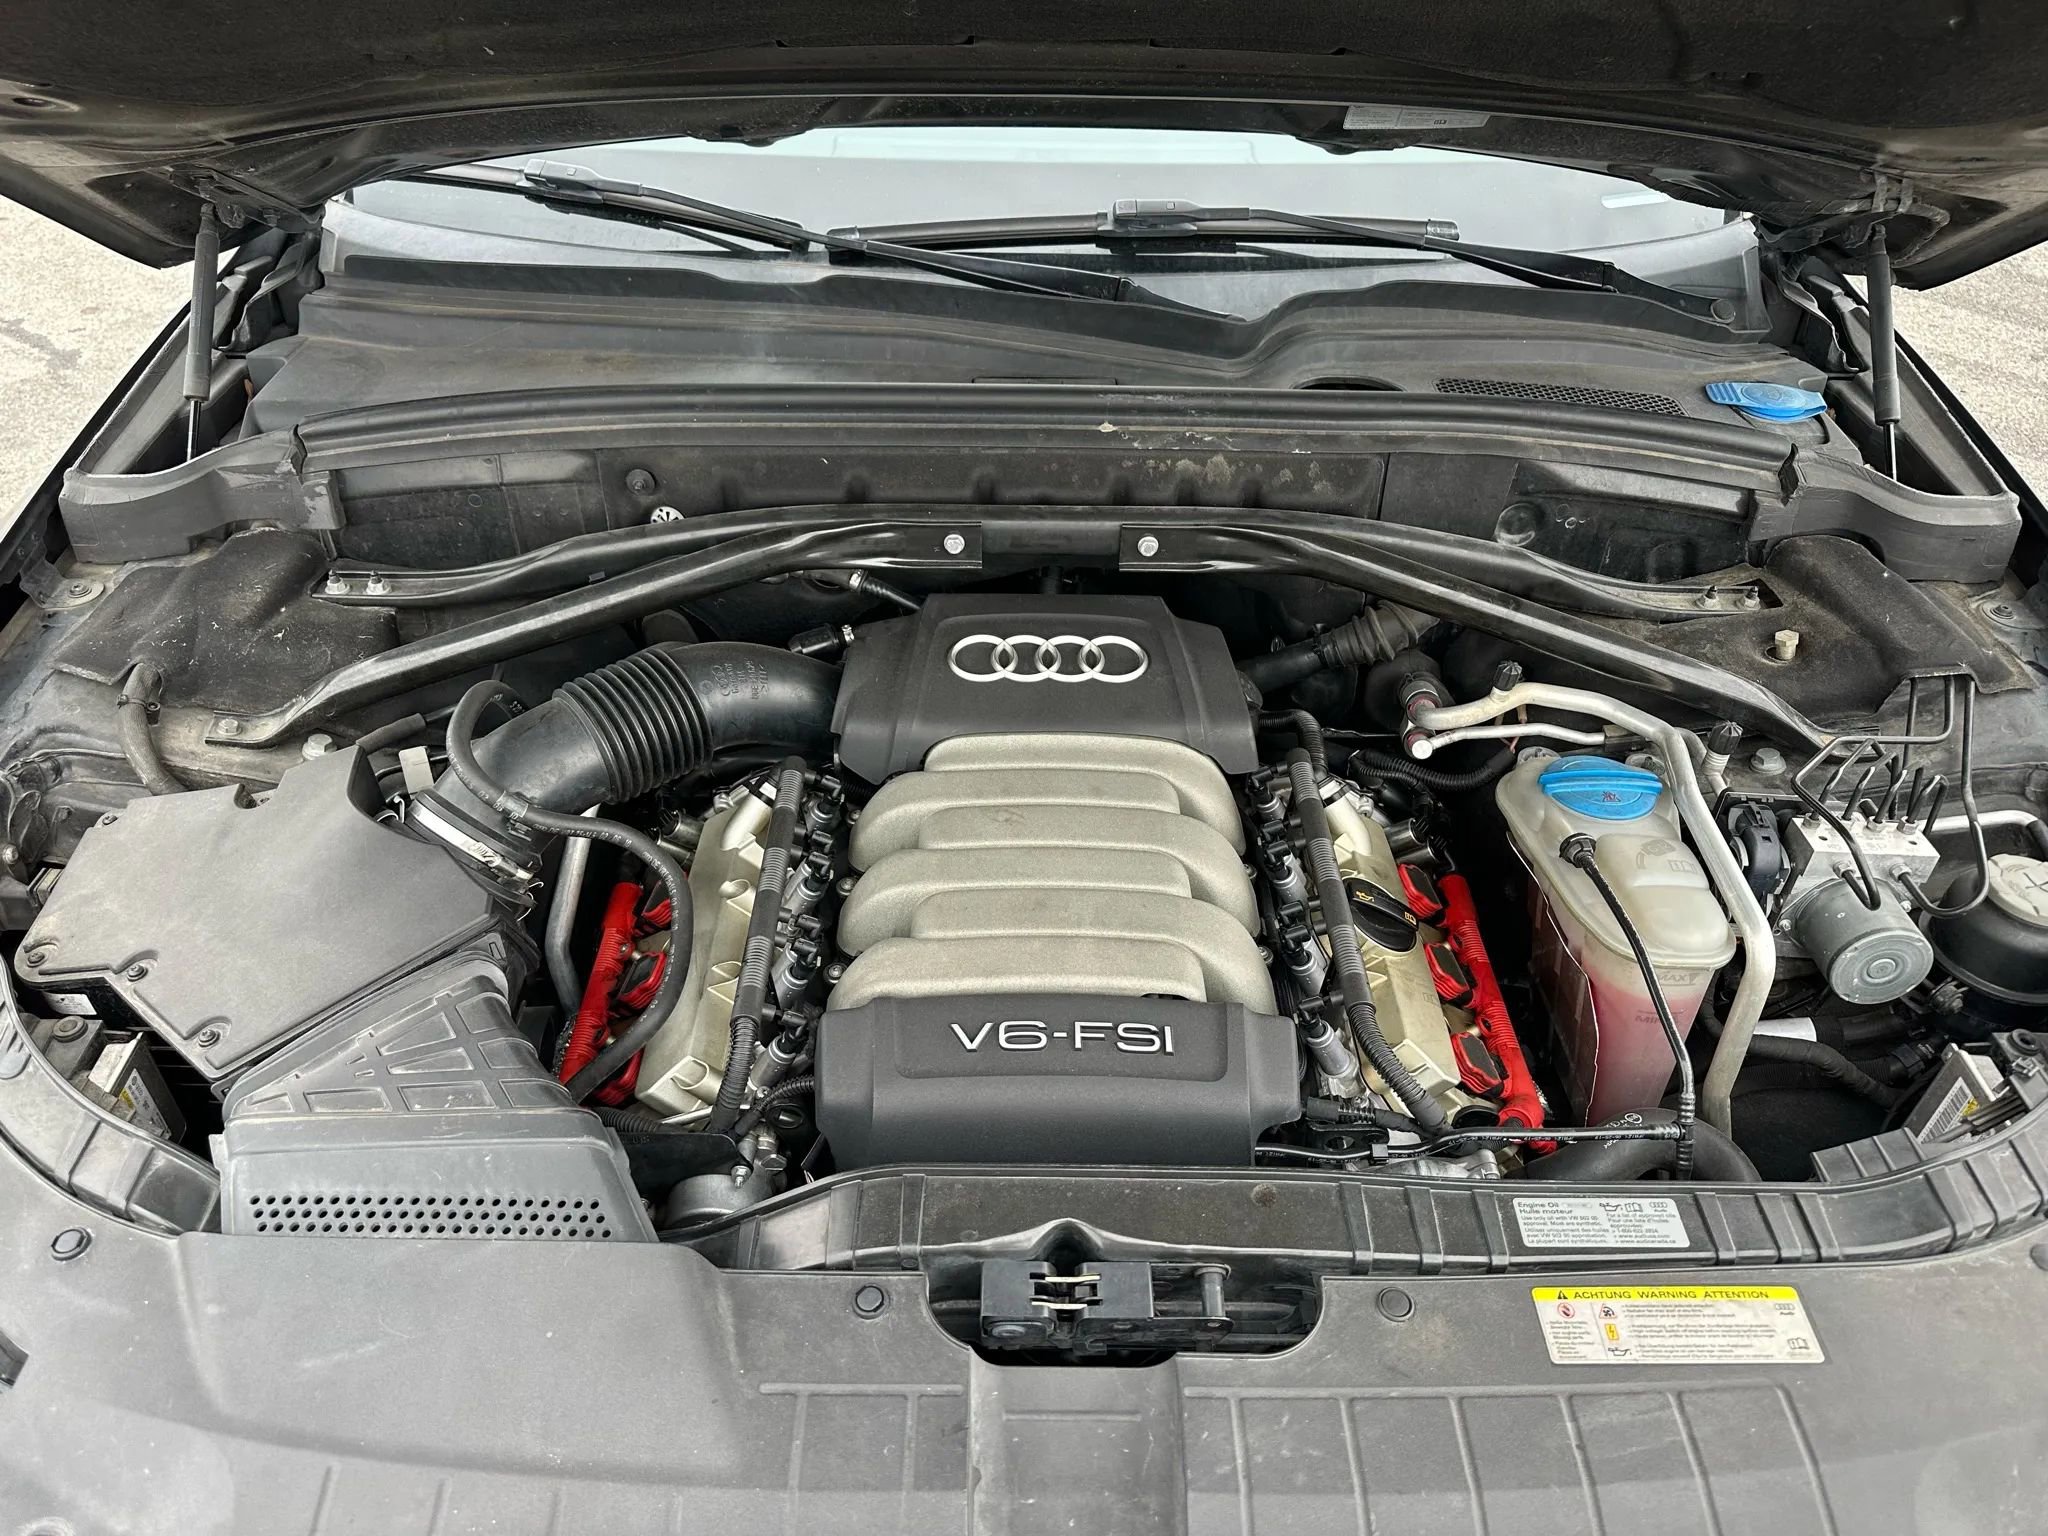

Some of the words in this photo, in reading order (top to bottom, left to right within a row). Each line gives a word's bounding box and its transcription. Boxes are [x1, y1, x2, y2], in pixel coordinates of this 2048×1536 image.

[950, 1020, 1175, 1056] V6-FSI
[1574, 1291, 1631, 1299] ACHTUNG
[1637, 1291, 1697, 1299] WARNING
[1703, 1291, 1769, 1299] ATTENTION
